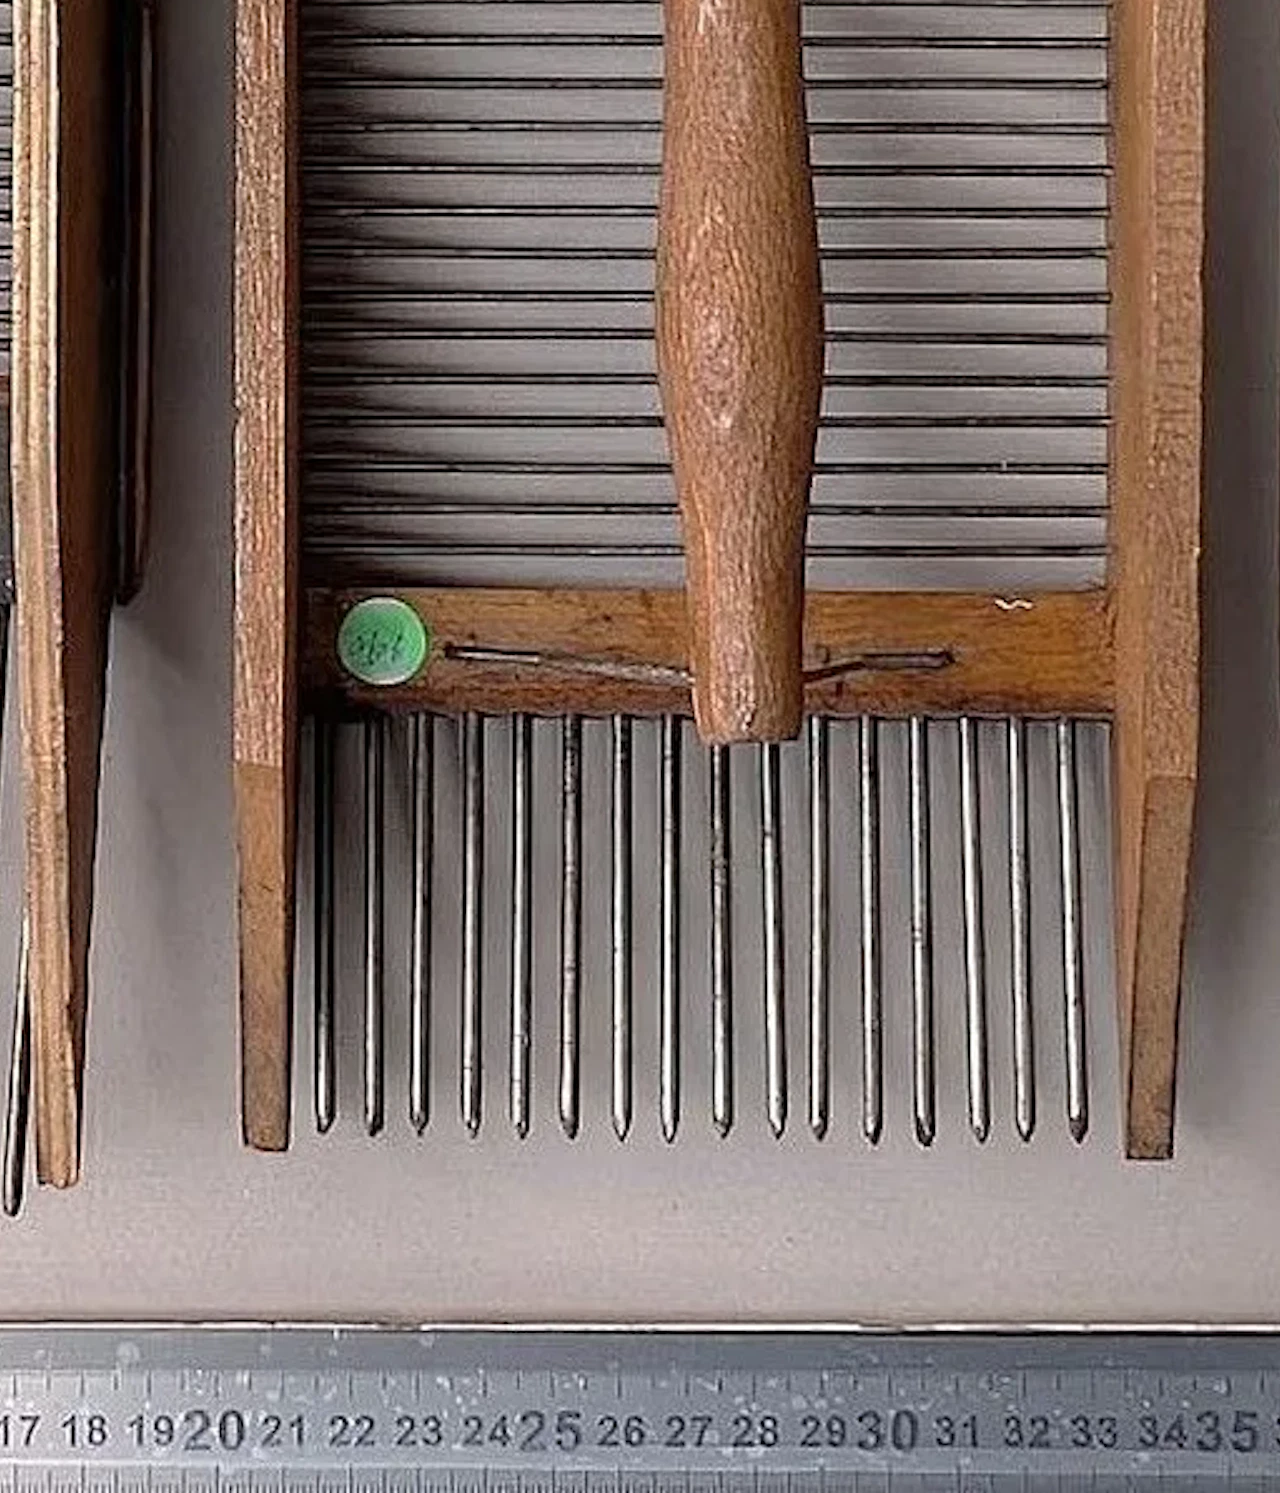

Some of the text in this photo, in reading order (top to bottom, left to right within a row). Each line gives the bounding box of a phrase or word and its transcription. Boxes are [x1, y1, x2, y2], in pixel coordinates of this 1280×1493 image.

[61, 1414, 108, 1448] 18
[128, 1414, 175, 1447] 19
[183, 1409, 246, 1452] 20
[261, 1414, 304, 1448] 21
[329, 1415, 375, 1448] 22
[395, 1414, 443, 1447] 23
[463, 1414, 511, 1448] 24
[519, 1410, 582, 1452] 25
[596, 1415, 646, 1448] 26
[664, 1415, 713, 1448] 27
[731, 1414, 779, 1448] 28
[800, 1415, 846, 1448] 29
[856, 1410, 918, 1451] 30
[935, 1415, 979, 1448] 31
[1004, 1415, 1051, 1449] 32
[1071, 1415, 1118, 1450] 33
[1139, 1415, 1188, 1449] 34
[1196, 1410, 1258, 1453] 35
